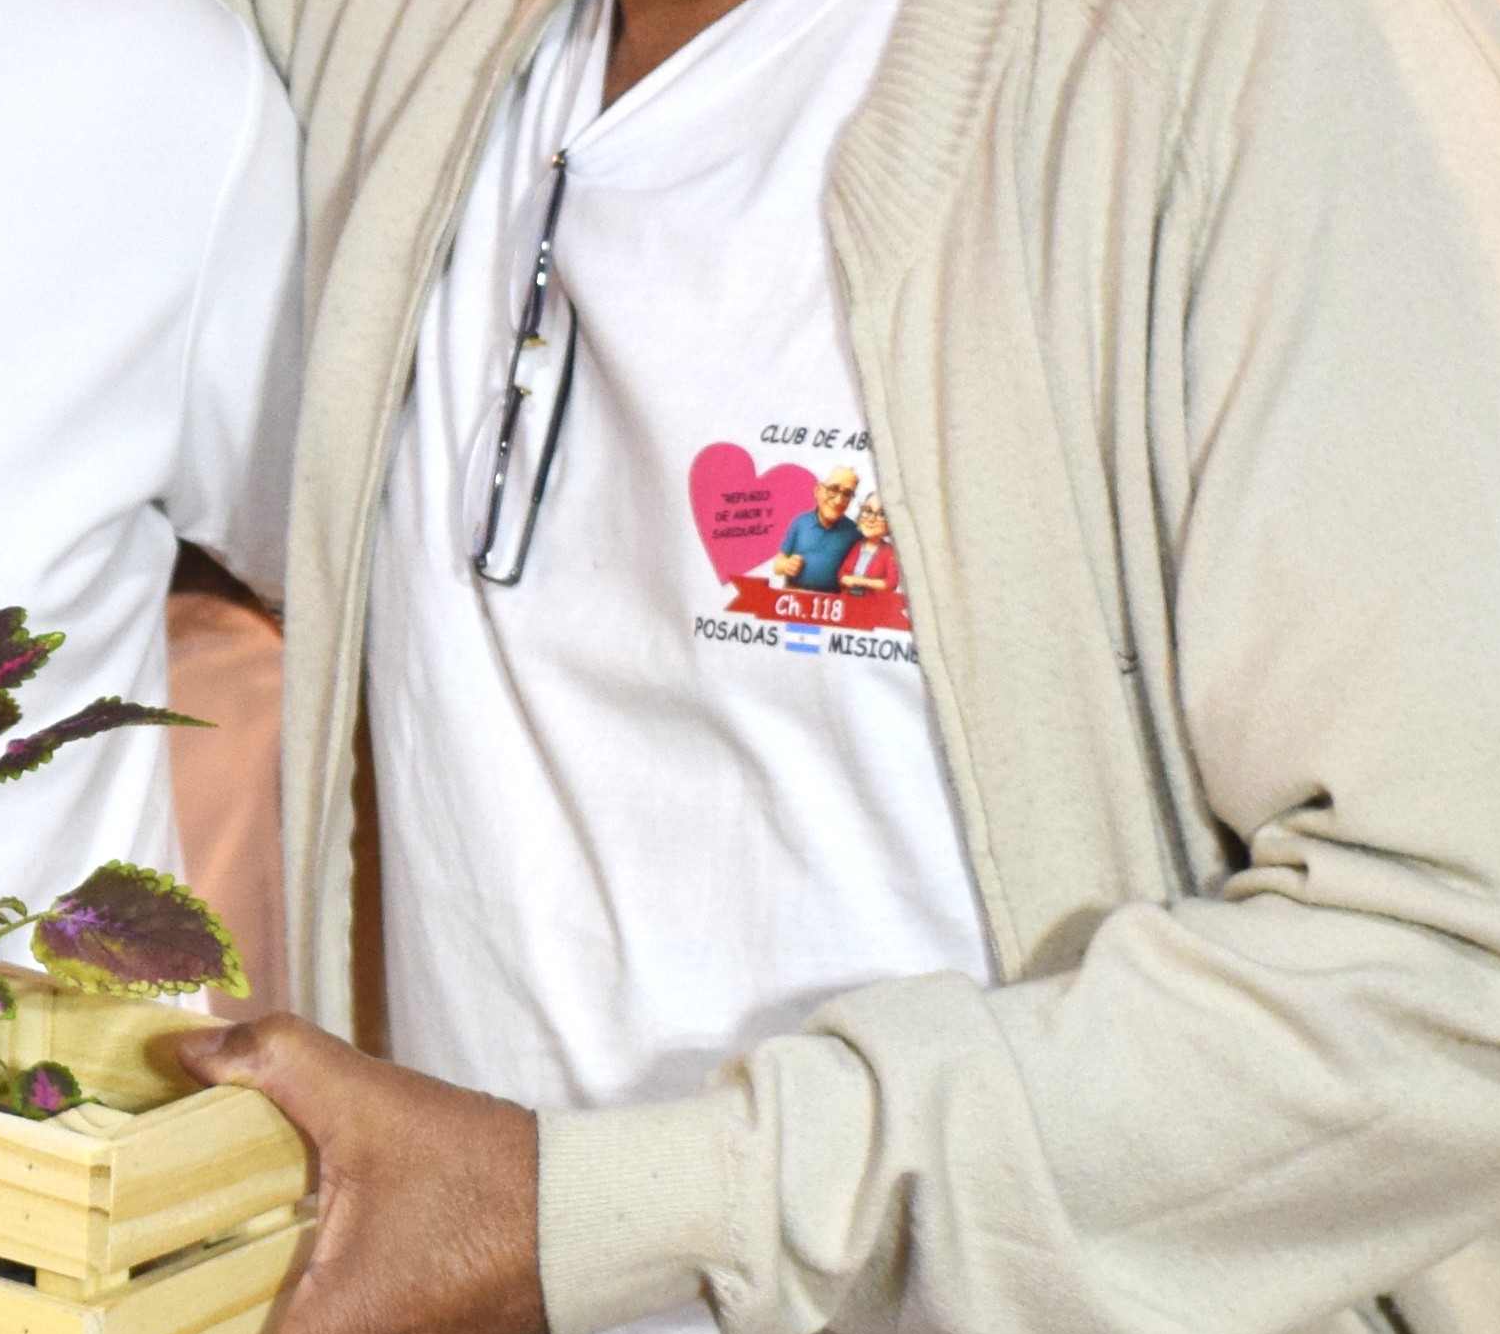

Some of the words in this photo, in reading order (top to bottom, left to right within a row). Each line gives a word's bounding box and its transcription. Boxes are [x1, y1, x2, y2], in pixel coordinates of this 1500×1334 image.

[760, 424, 807, 445] CLUB
[812, 428, 840, 448] DE
[842, 430, 874, 451] AB
[810, 596, 844, 621] 118
[694, 616, 778, 646] POSADAS
[828, 633, 919, 664] MISIONE
